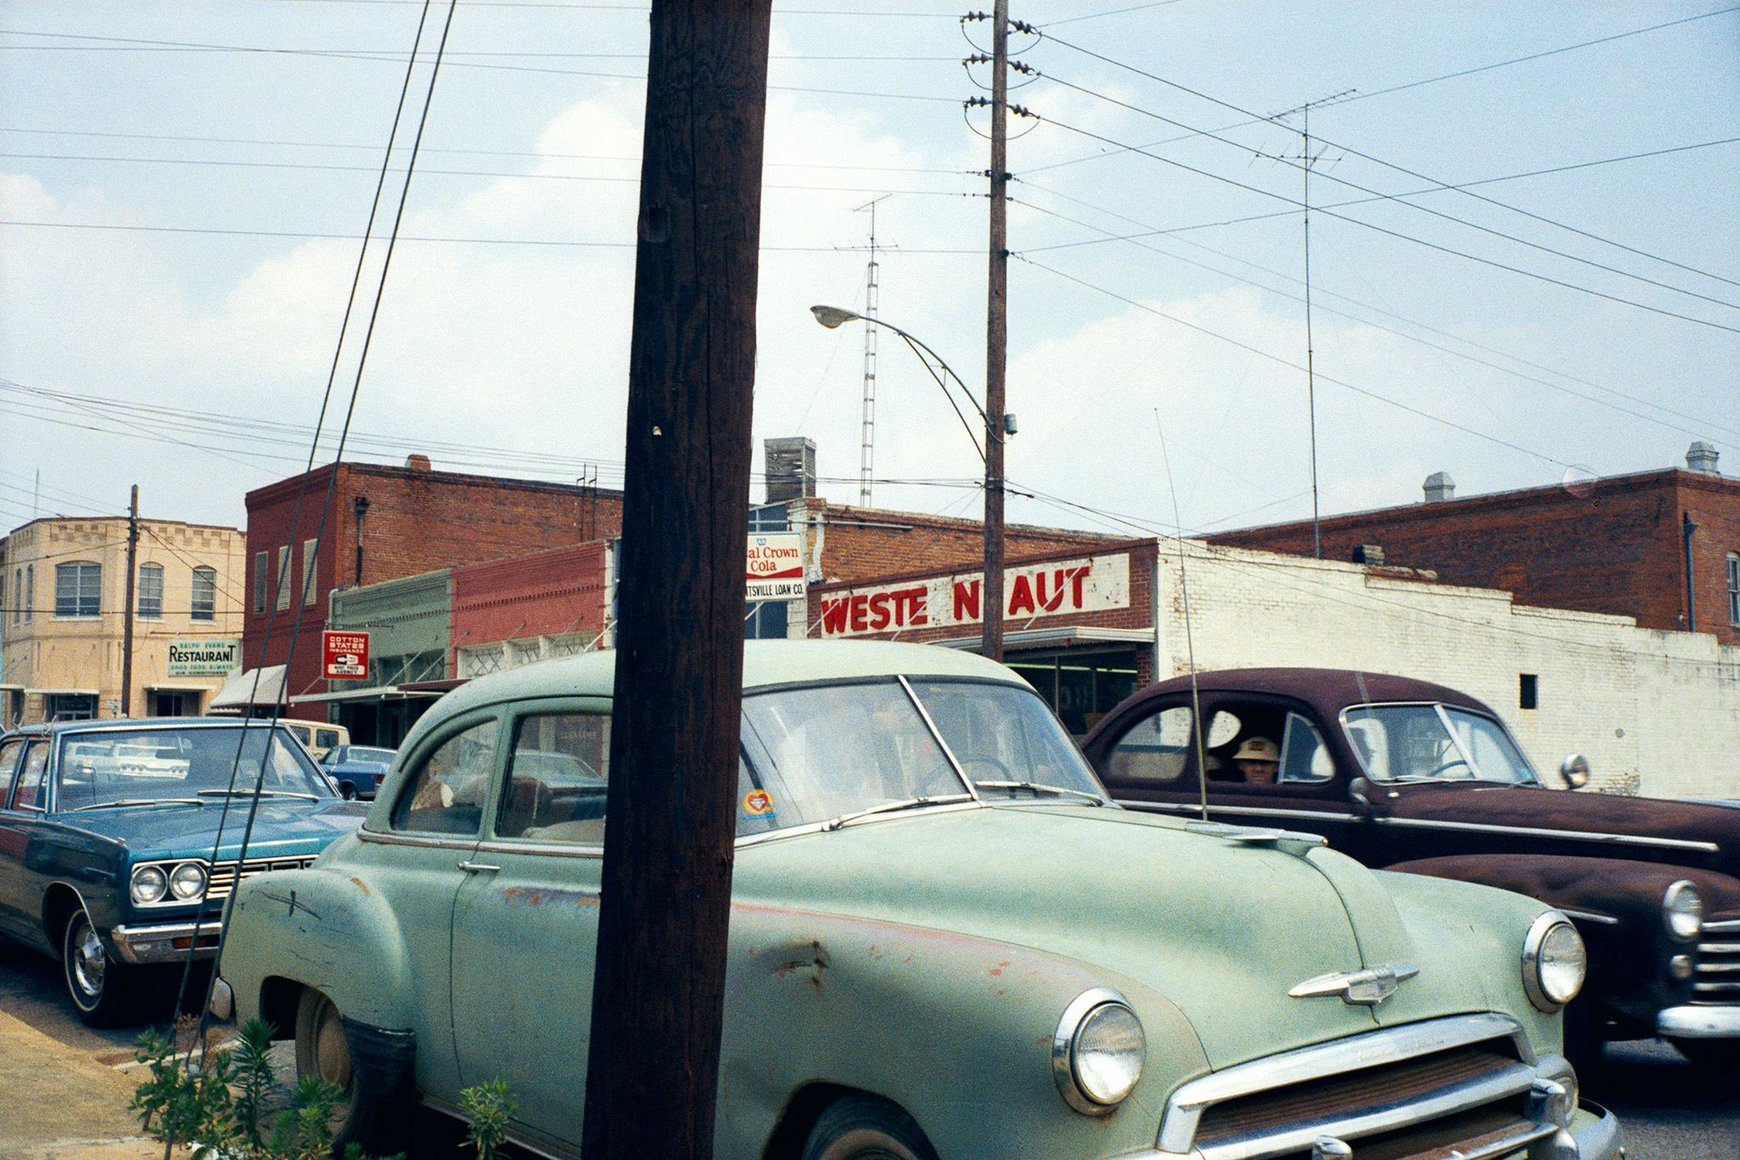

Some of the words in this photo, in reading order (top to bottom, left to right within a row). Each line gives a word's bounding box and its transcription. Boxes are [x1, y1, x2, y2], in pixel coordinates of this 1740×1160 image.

[747, 546, 760, 558] al
[763, 546, 799, 558] Crown
[750, 560, 777, 572] Cola
[775, 584, 791, 595] LOAN
[793, 584, 804, 595] CO.
[821, 580, 980, 634] WESTEN
